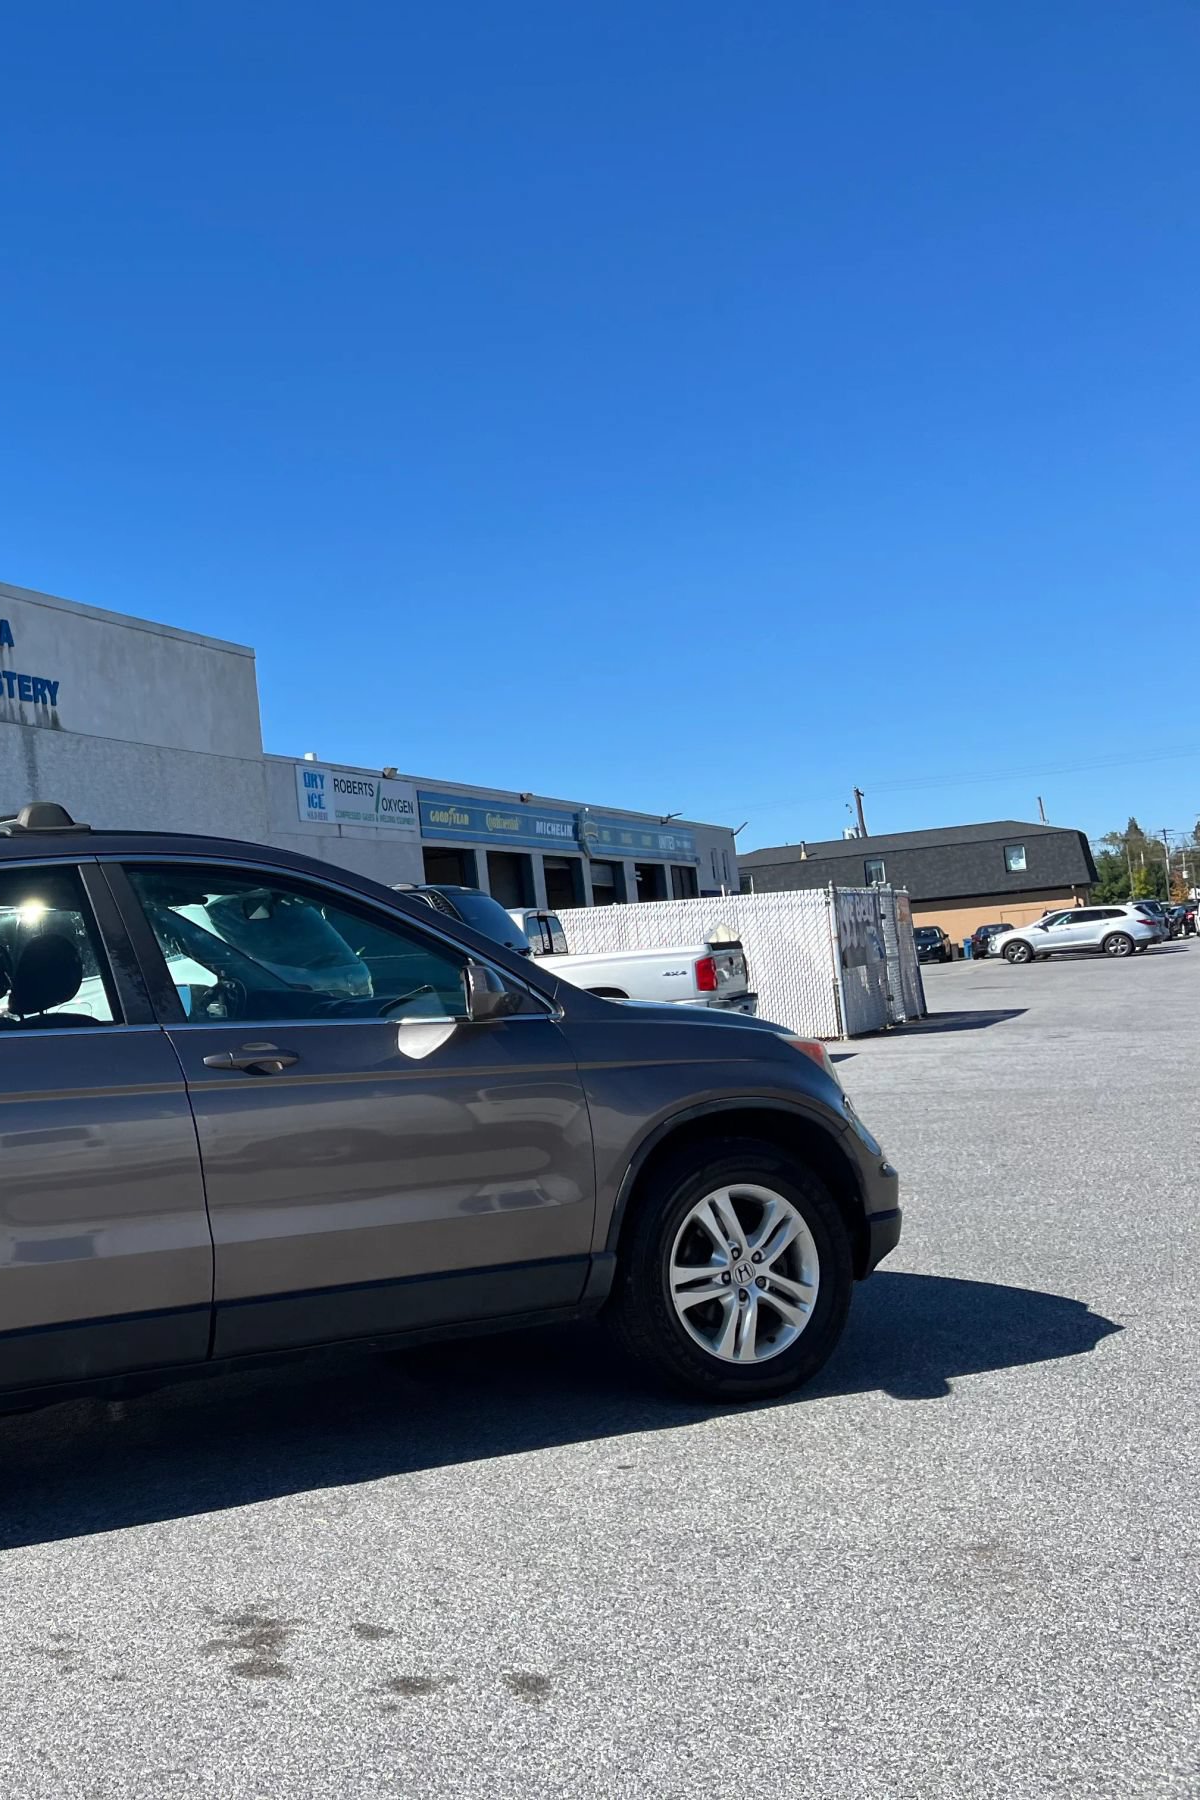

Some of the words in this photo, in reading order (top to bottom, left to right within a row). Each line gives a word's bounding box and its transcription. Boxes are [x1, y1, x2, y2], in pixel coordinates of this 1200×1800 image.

[303, 771, 325, 789] DRY
[333, 778, 375, 798] ROBERTS
[307, 792, 326, 810] ICE
[381, 797, 414, 814] OXYGEN
[535, 820, 573, 837] MICHELIN
